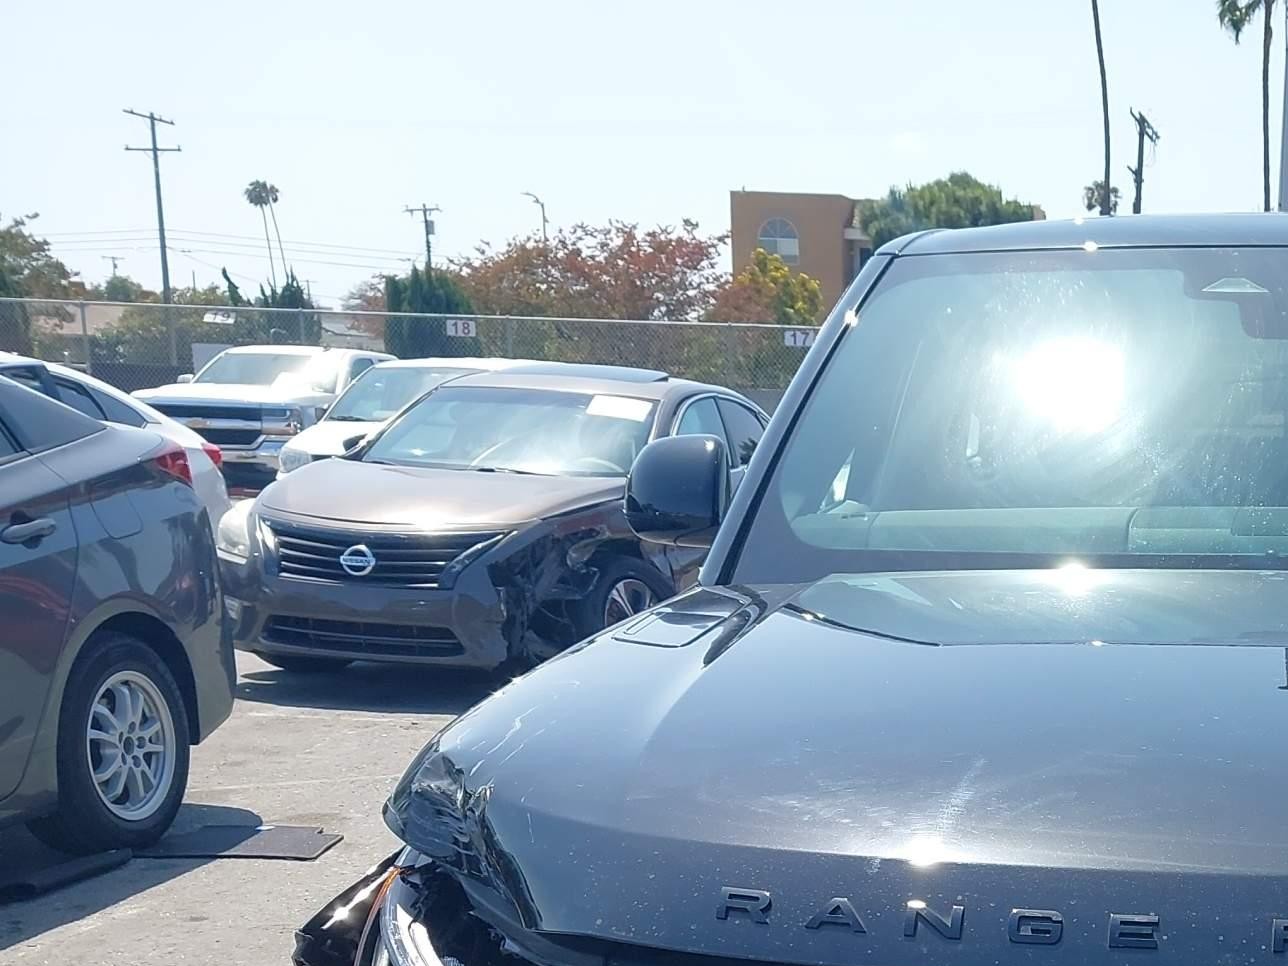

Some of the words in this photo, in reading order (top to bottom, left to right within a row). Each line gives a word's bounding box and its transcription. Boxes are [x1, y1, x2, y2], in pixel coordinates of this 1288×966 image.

[451, 321, 471, 336] 18
[790, 331, 810, 345] 17
[715, 885, 1161, 950] RANGE
